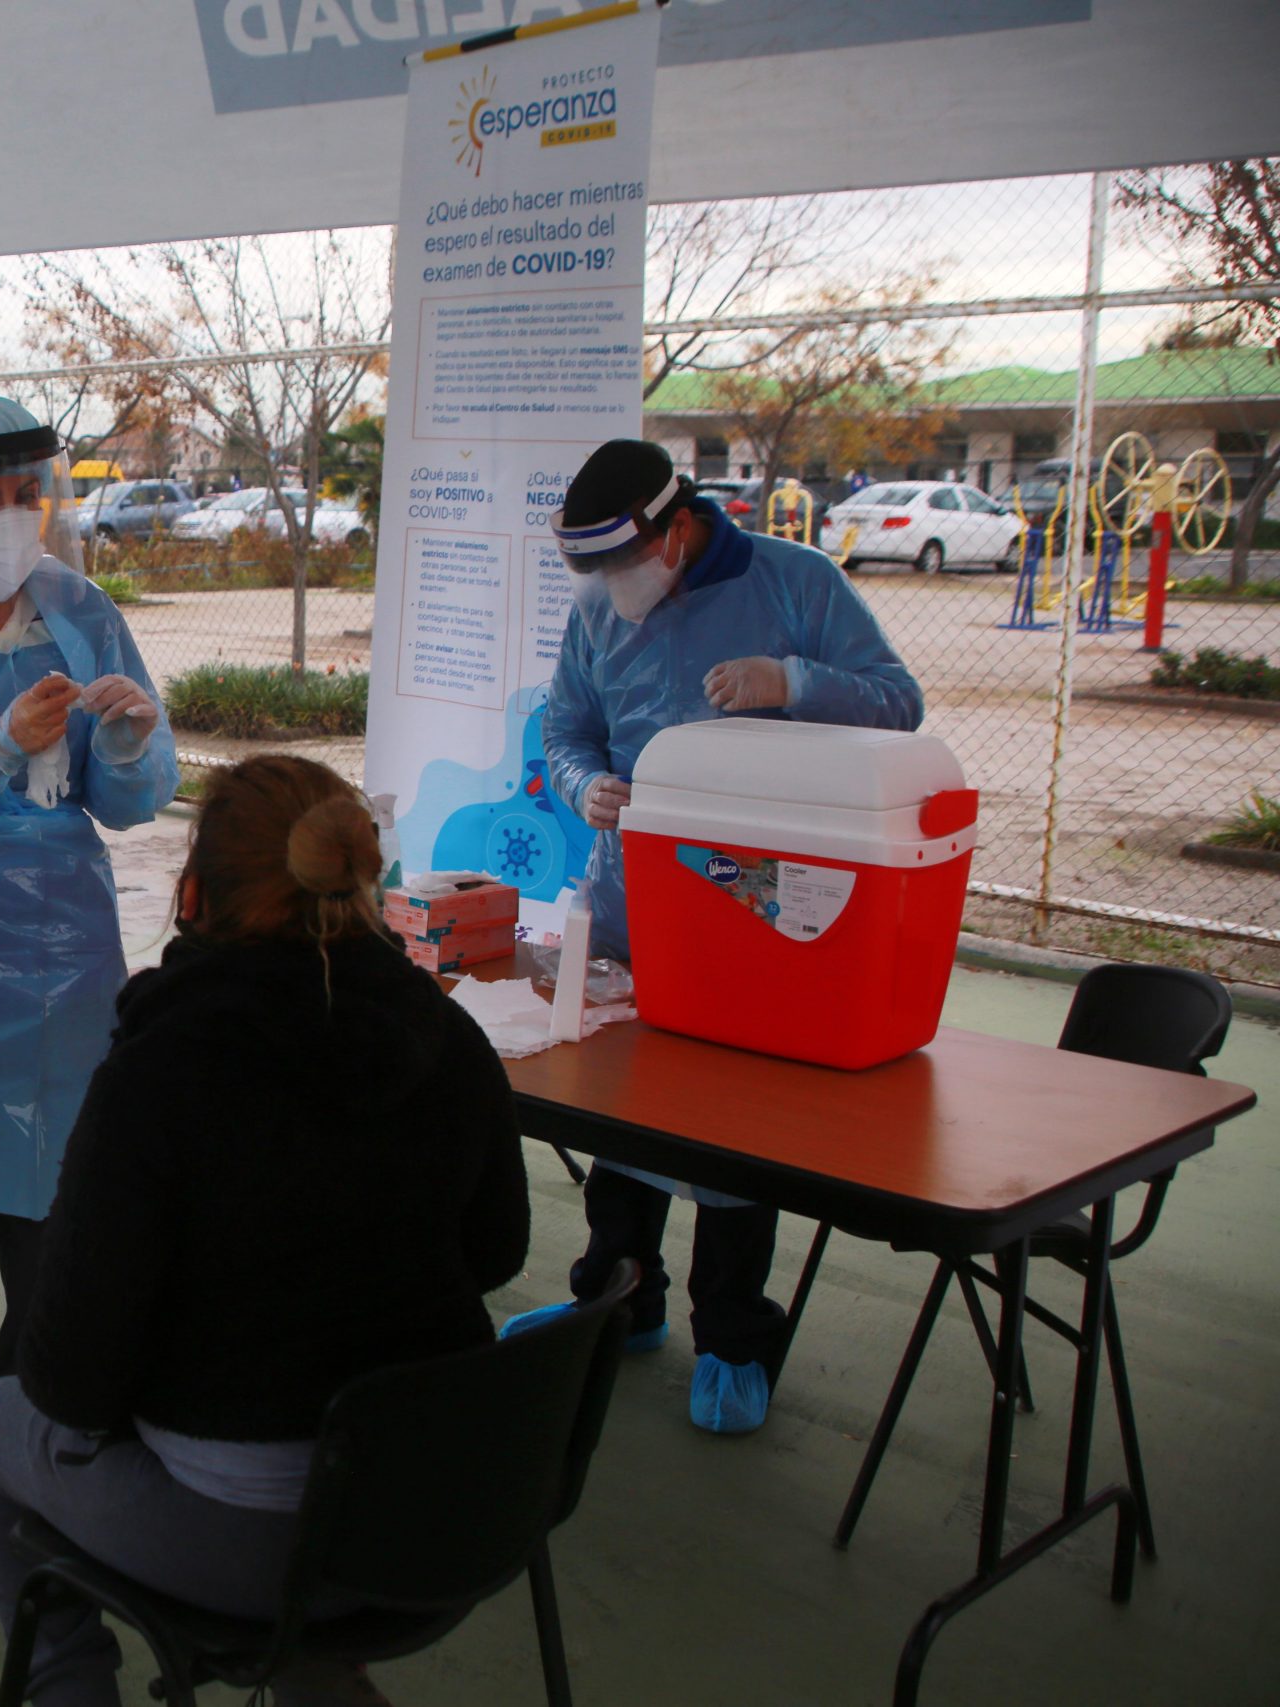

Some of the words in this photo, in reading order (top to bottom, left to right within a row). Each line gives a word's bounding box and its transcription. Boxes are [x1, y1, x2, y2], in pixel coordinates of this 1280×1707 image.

[542, 64, 615, 89] PROYECTO
[479, 87, 616, 139] esperanza
[547, 123, 612, 143] COVID-19
[426, 197, 467, 226] ¿Qué
[472, 196, 509, 218] debo
[513, 189, 564, 213] hacer
[570, 180, 644, 207] mientras
[424, 234, 477, 256] espero
[481, 225, 493, 247] el
[497, 216, 582, 246] resultado
[587, 212, 615, 238] del
[423, 261, 483, 284] examen
[487, 255, 507, 277] de
[512, 247, 615, 275] COVID-19?
[580, 302, 593, 310] con
[595, 300, 614, 309] otras
[515, 314, 554, 324] residencia
[556, 314, 587, 323] sanitaria
[511, 329, 517, 337] o
[518, 327, 528, 337] de
[529, 326, 567, 337] autoridad
[580, 345, 612, 356] mensaje
[521, 369, 532, 380] de
[533, 370, 559, 380] recibir
[560, 370, 569, 380] el
[548, 384, 559, 393] su
[495, 401, 519, 412] Centro
[520, 401, 531, 412] de
[531, 401, 555, 413] Salud
[563, 403, 590, 412] menos
[592, 404, 608, 414] que
[410, 467, 444, 483] ¿Qué
[446, 471, 469, 484] pasa
[471, 469, 480, 482] si
[527, 471, 562, 487] ¿Qué
[409, 488, 433, 503] soy
[435, 487, 486, 503] POSITIVO
[487, 492, 494, 504] a
[526, 491, 565, 507] NEGA
[407, 504, 468, 522] COVID-19?
[525, 511, 549, 526] CO
[540, 546, 557, 558] Siga
[539, 559, 550, 569] de
[552, 559, 564, 569] las
[545, 595, 559, 605] del
[418, 600, 426, 609] El
[484, 610, 494, 618] no
[537, 625, 562, 636] Mante
[415, 640, 434, 651] Debe
[435, 643, 455, 654] avisar
[414, 664, 428, 673] con
[426, 677, 435, 685] de
[709, 860, 737, 877] Wenco
[784, 865, 807, 876] Cooler
